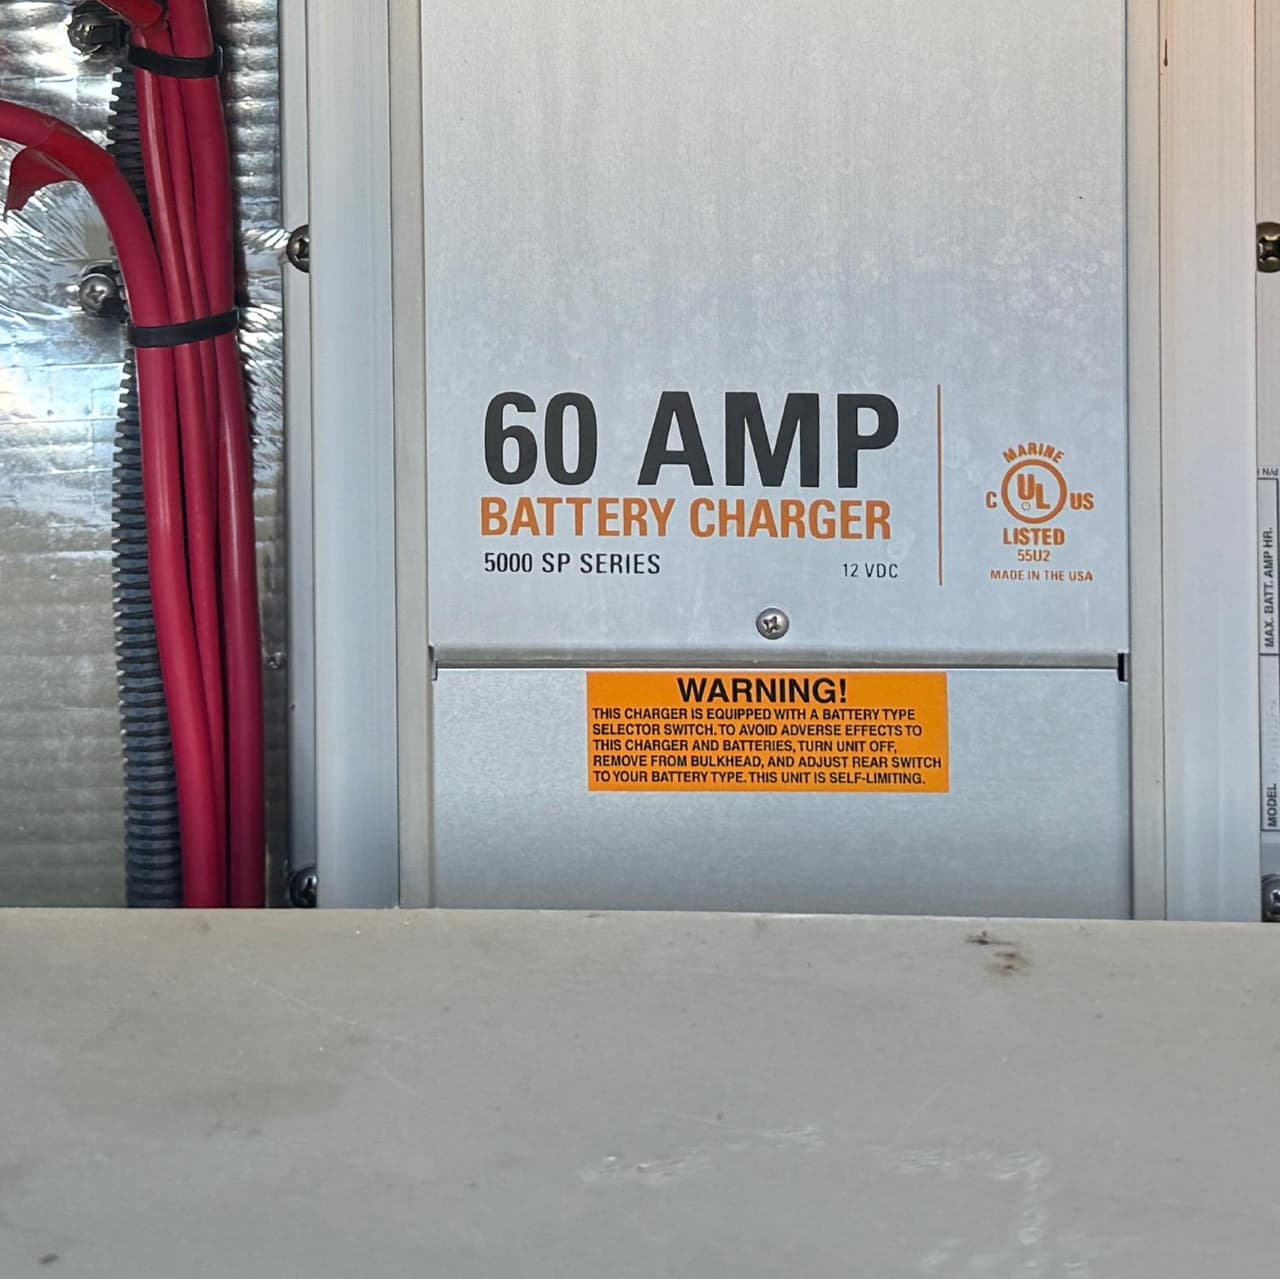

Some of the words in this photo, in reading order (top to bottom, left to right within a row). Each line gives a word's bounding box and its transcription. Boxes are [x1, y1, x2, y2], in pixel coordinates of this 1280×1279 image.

[484, 392, 597, 485] 60
[637, 391, 900, 488] AMP
[1003, 442, 1064, 463] MARINE
[1017, 474, 1050, 509] UL
[1070, 492, 1095, 510] US
[480, 496, 675, 537] BATTERY
[689, 497, 891, 540] CHARGER
[1003, 528, 1065, 545] LISTED
[1262, 527, 1274, 548] HR.
[484, 552, 533, 574] 5000
[542, 552, 570, 574] SP
[580, 552, 661, 575] SERIES
[1017, 549, 1050, 562] 55U2
[1263, 550, 1275, 578] AMP
[843, 563, 858, 578] 12
[864, 563, 898, 579] VDC
[990, 570, 1024, 581] MADE
[1028, 570, 1040, 581] IN
[1044, 570, 1064, 581] THE
[1069, 570, 1094, 581] USA
[1263, 580, 1275, 614] BATT.
[1263, 617, 1275, 648] MAX.
[677, 677, 847, 704] WARNING!
[593, 708, 620, 720] THIS
[625, 708, 687, 720] CHARGER
[692, 708, 703, 720] IS
[707, 709, 771, 721] EQUIPPED
[775, 709, 806, 721] WITH
[810, 709, 817, 721] A
[822, 709, 879, 721] BATTERY
[882, 709, 915, 721] TYPE
[592, 723, 660, 735] SELECTOR
[663, 723, 717, 735] SWITCH.
[718, 723, 735, 735] TO
[738, 724, 777, 736] AVOID
[781, 724, 841, 736] ADVERSE
[845, 724, 903, 736] EFFECTS
[906, 724, 922, 736] TO
[593, 739, 621, 751] THIS
[625, 739, 688, 751] CHARGER
[692, 739, 719, 751] AND
[722, 740, 796, 754] BATTERIES,
[799, 740, 832, 752] TURN
[836, 740, 866, 752] UNIT
[869, 740, 896, 754] OFF,
[593, 755, 647, 767] REMOVE
[650, 755, 687, 767] FROM
[691, 755, 764, 769] BULKHEAD,
[767, 756, 795, 768] AND
[798, 756, 848, 768] ADJUST
[852, 756, 889, 768] REAR
[892, 756, 942, 768] SWITCH
[593, 771, 610, 783] TO
[613, 771, 647, 783] YOUR
[651, 771, 708, 783] BATTERY
[710, 771, 746, 783] TYPE.
[748, 772, 778, 784] THIS
[781, 772, 811, 784] UNIT
[814, 772, 826, 784] IS
[829, 772, 925, 784] SELF-LIMITING.
[1266, 782, 1278, 828] MODEL
